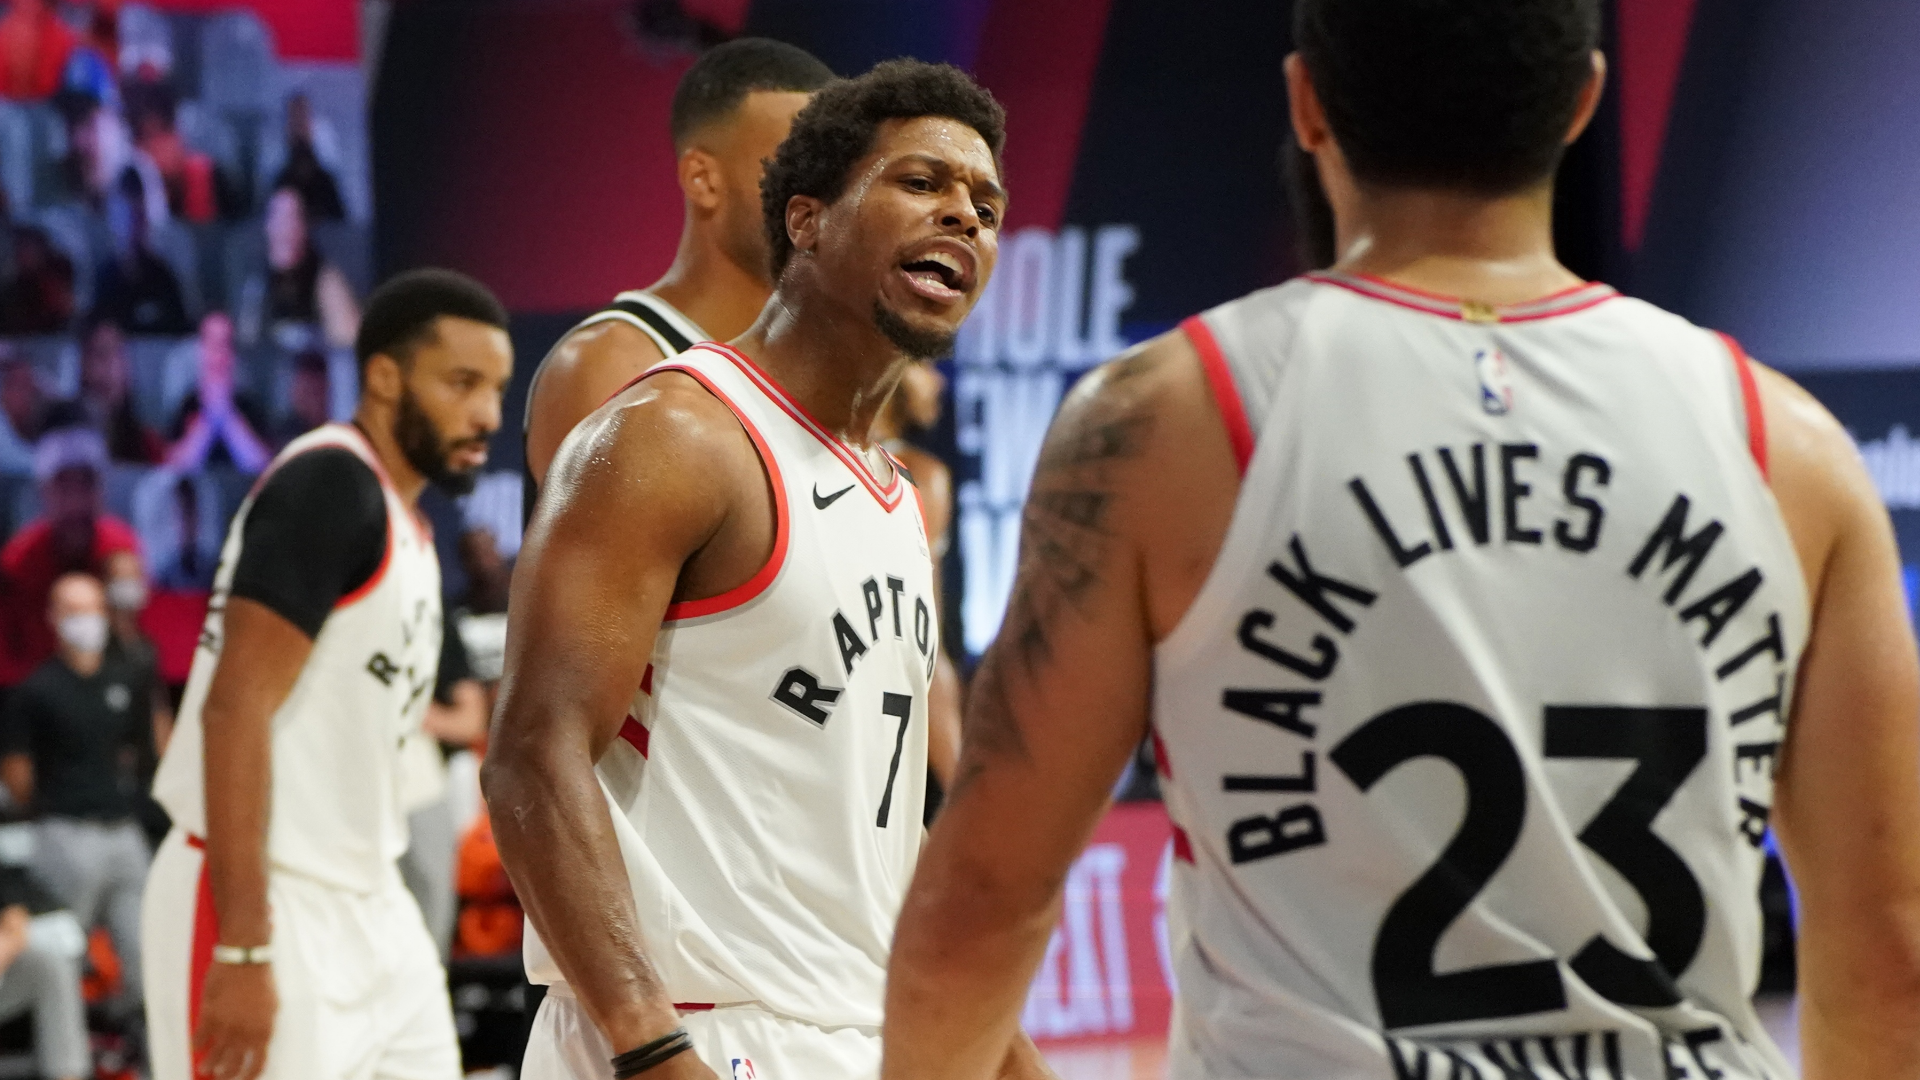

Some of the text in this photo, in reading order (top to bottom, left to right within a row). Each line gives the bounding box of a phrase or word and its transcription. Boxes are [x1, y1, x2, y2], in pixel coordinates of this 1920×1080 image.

[876, 691, 913, 828] 7
[1222, 532, 1379, 864] BLACK
[1347, 442, 1613, 569] LIVES
[1626, 493, 1786, 849] MATTER
[1327, 701, 1709, 1029] 23
